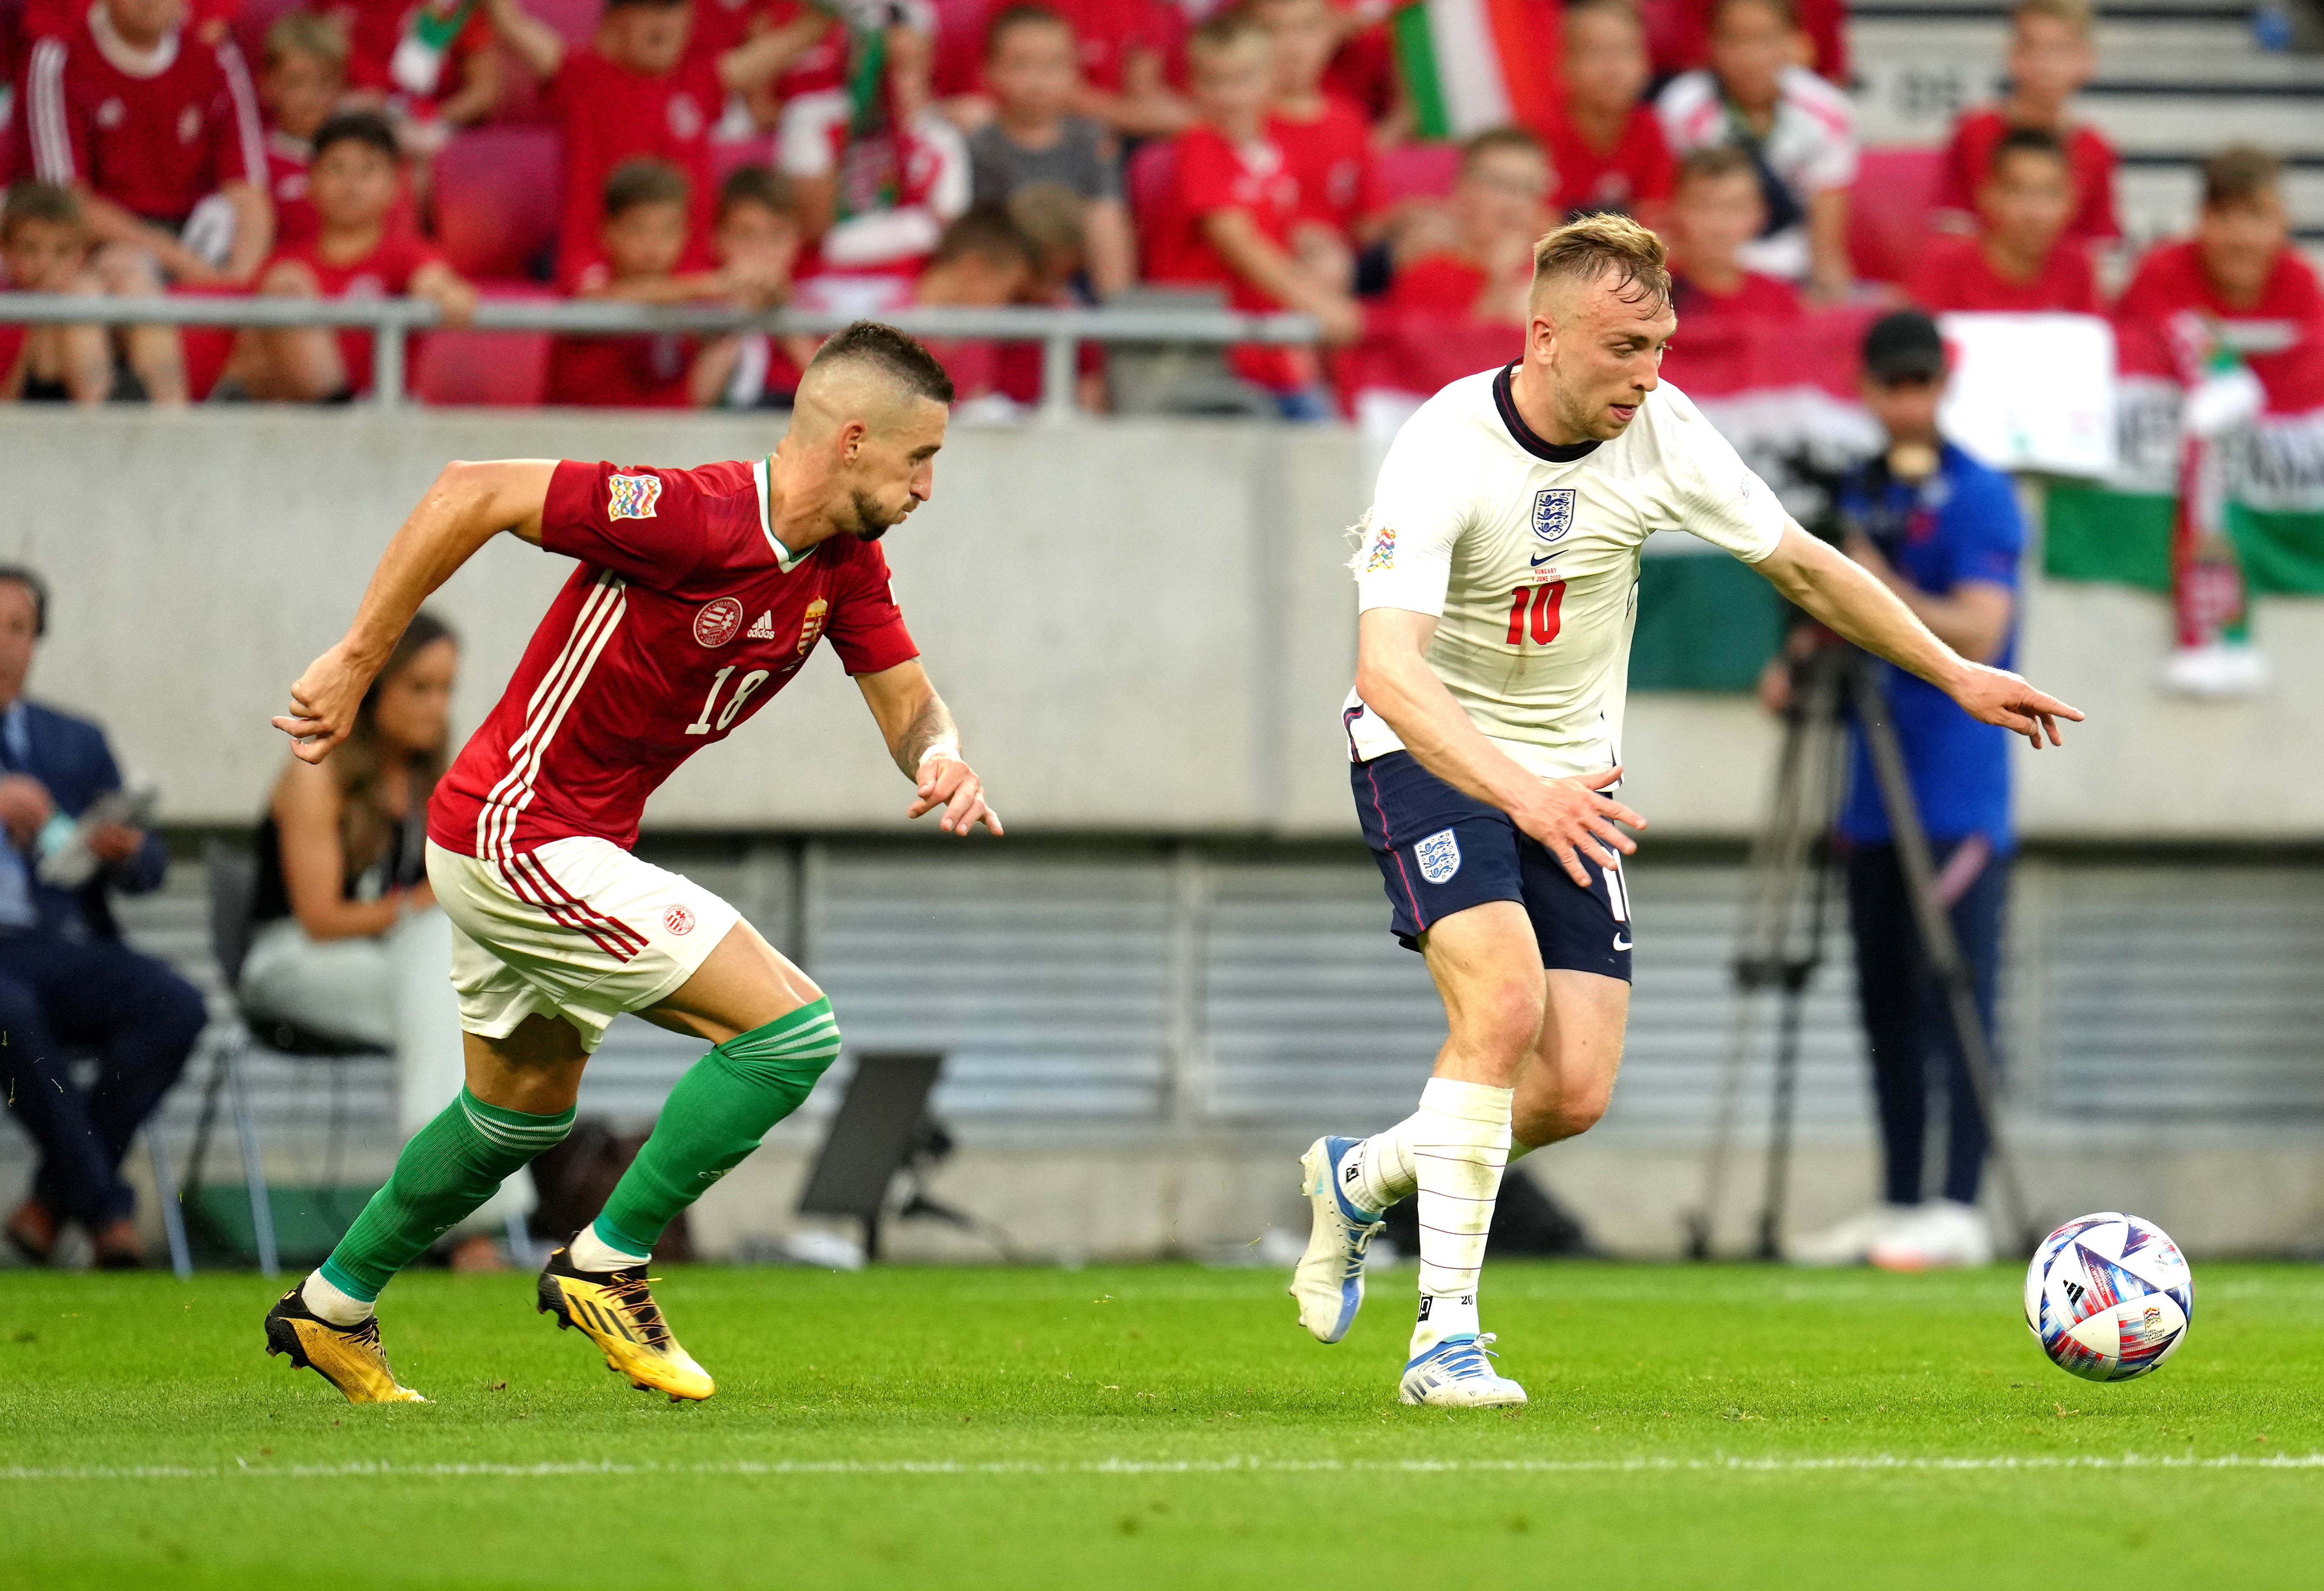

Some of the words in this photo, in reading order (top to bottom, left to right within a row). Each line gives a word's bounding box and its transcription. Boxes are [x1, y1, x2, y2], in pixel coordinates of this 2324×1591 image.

[1506, 580, 1567, 645] 10
[747, 627, 775, 639] adidas
[685, 665, 769, 735] 18
[2145, 1328, 2165, 1337] NATIONS
